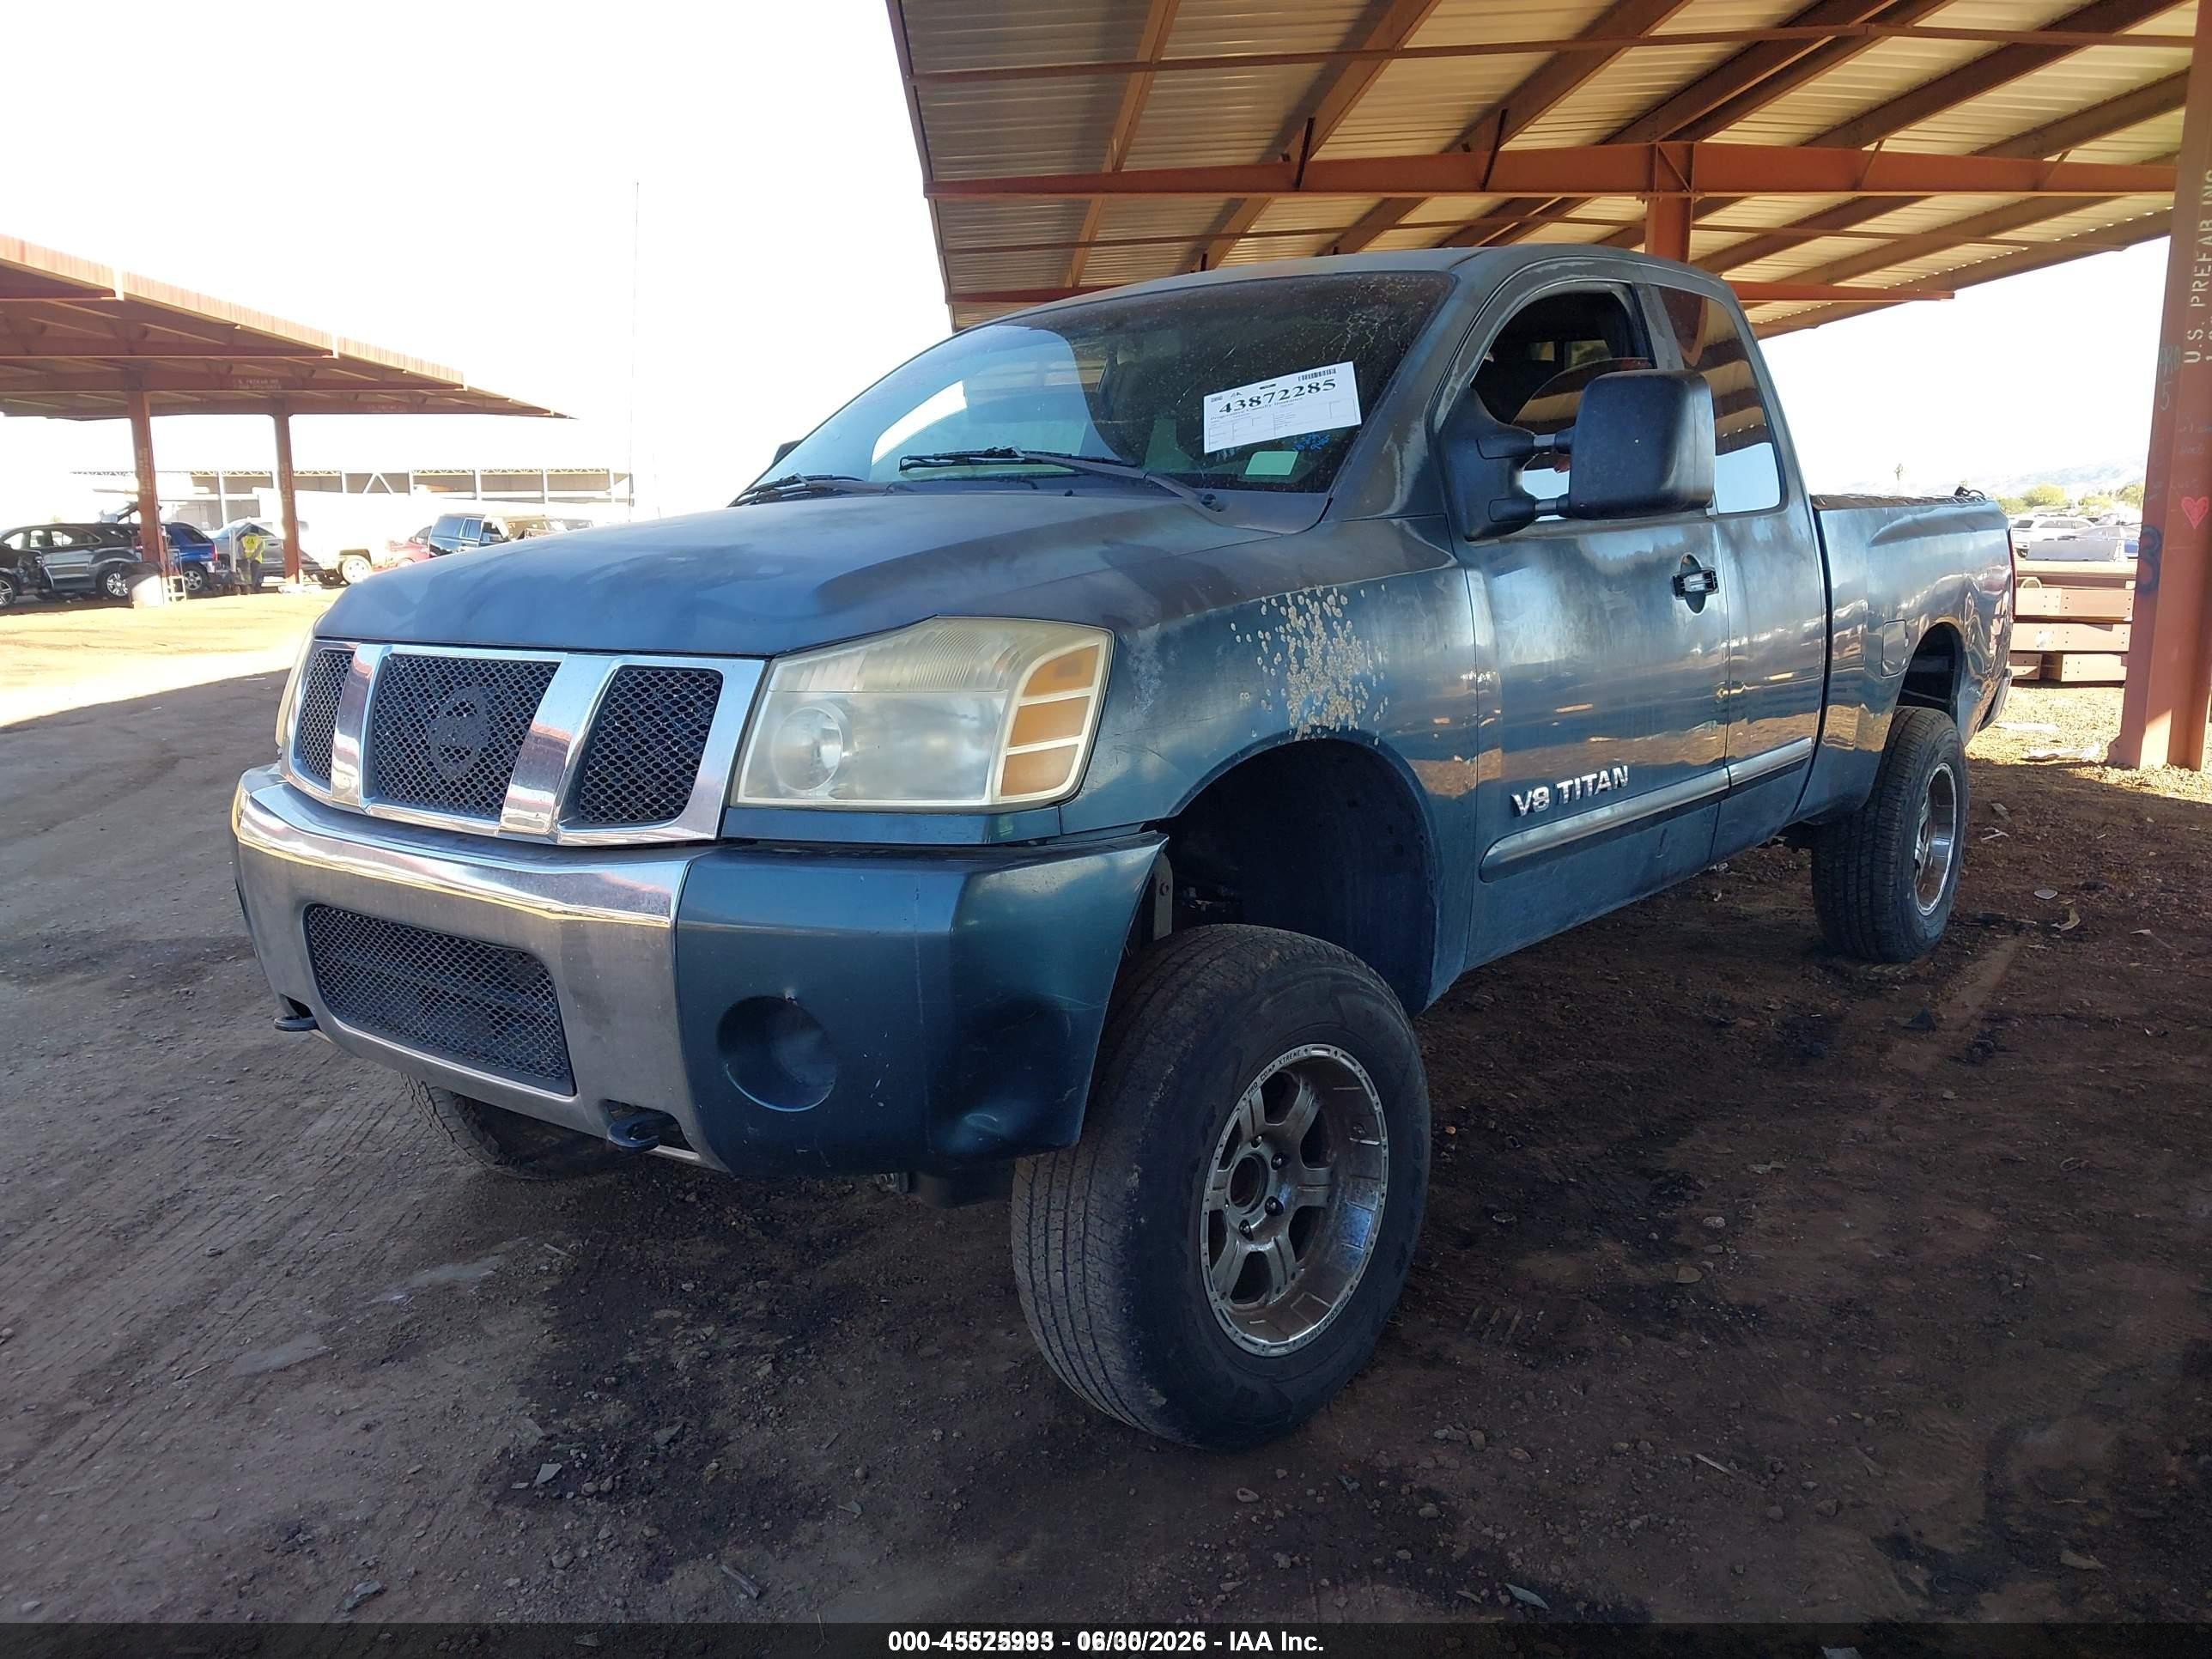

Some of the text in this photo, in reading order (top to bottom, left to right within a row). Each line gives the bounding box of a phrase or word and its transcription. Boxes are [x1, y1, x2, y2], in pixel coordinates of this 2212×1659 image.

[2190, 219, 2212, 307] PREFAB
[2184, 323, 2204, 364] U.S.
[1218, 378, 1337, 413] 43872285
[1510, 765, 1629, 817] V8 TITAN
